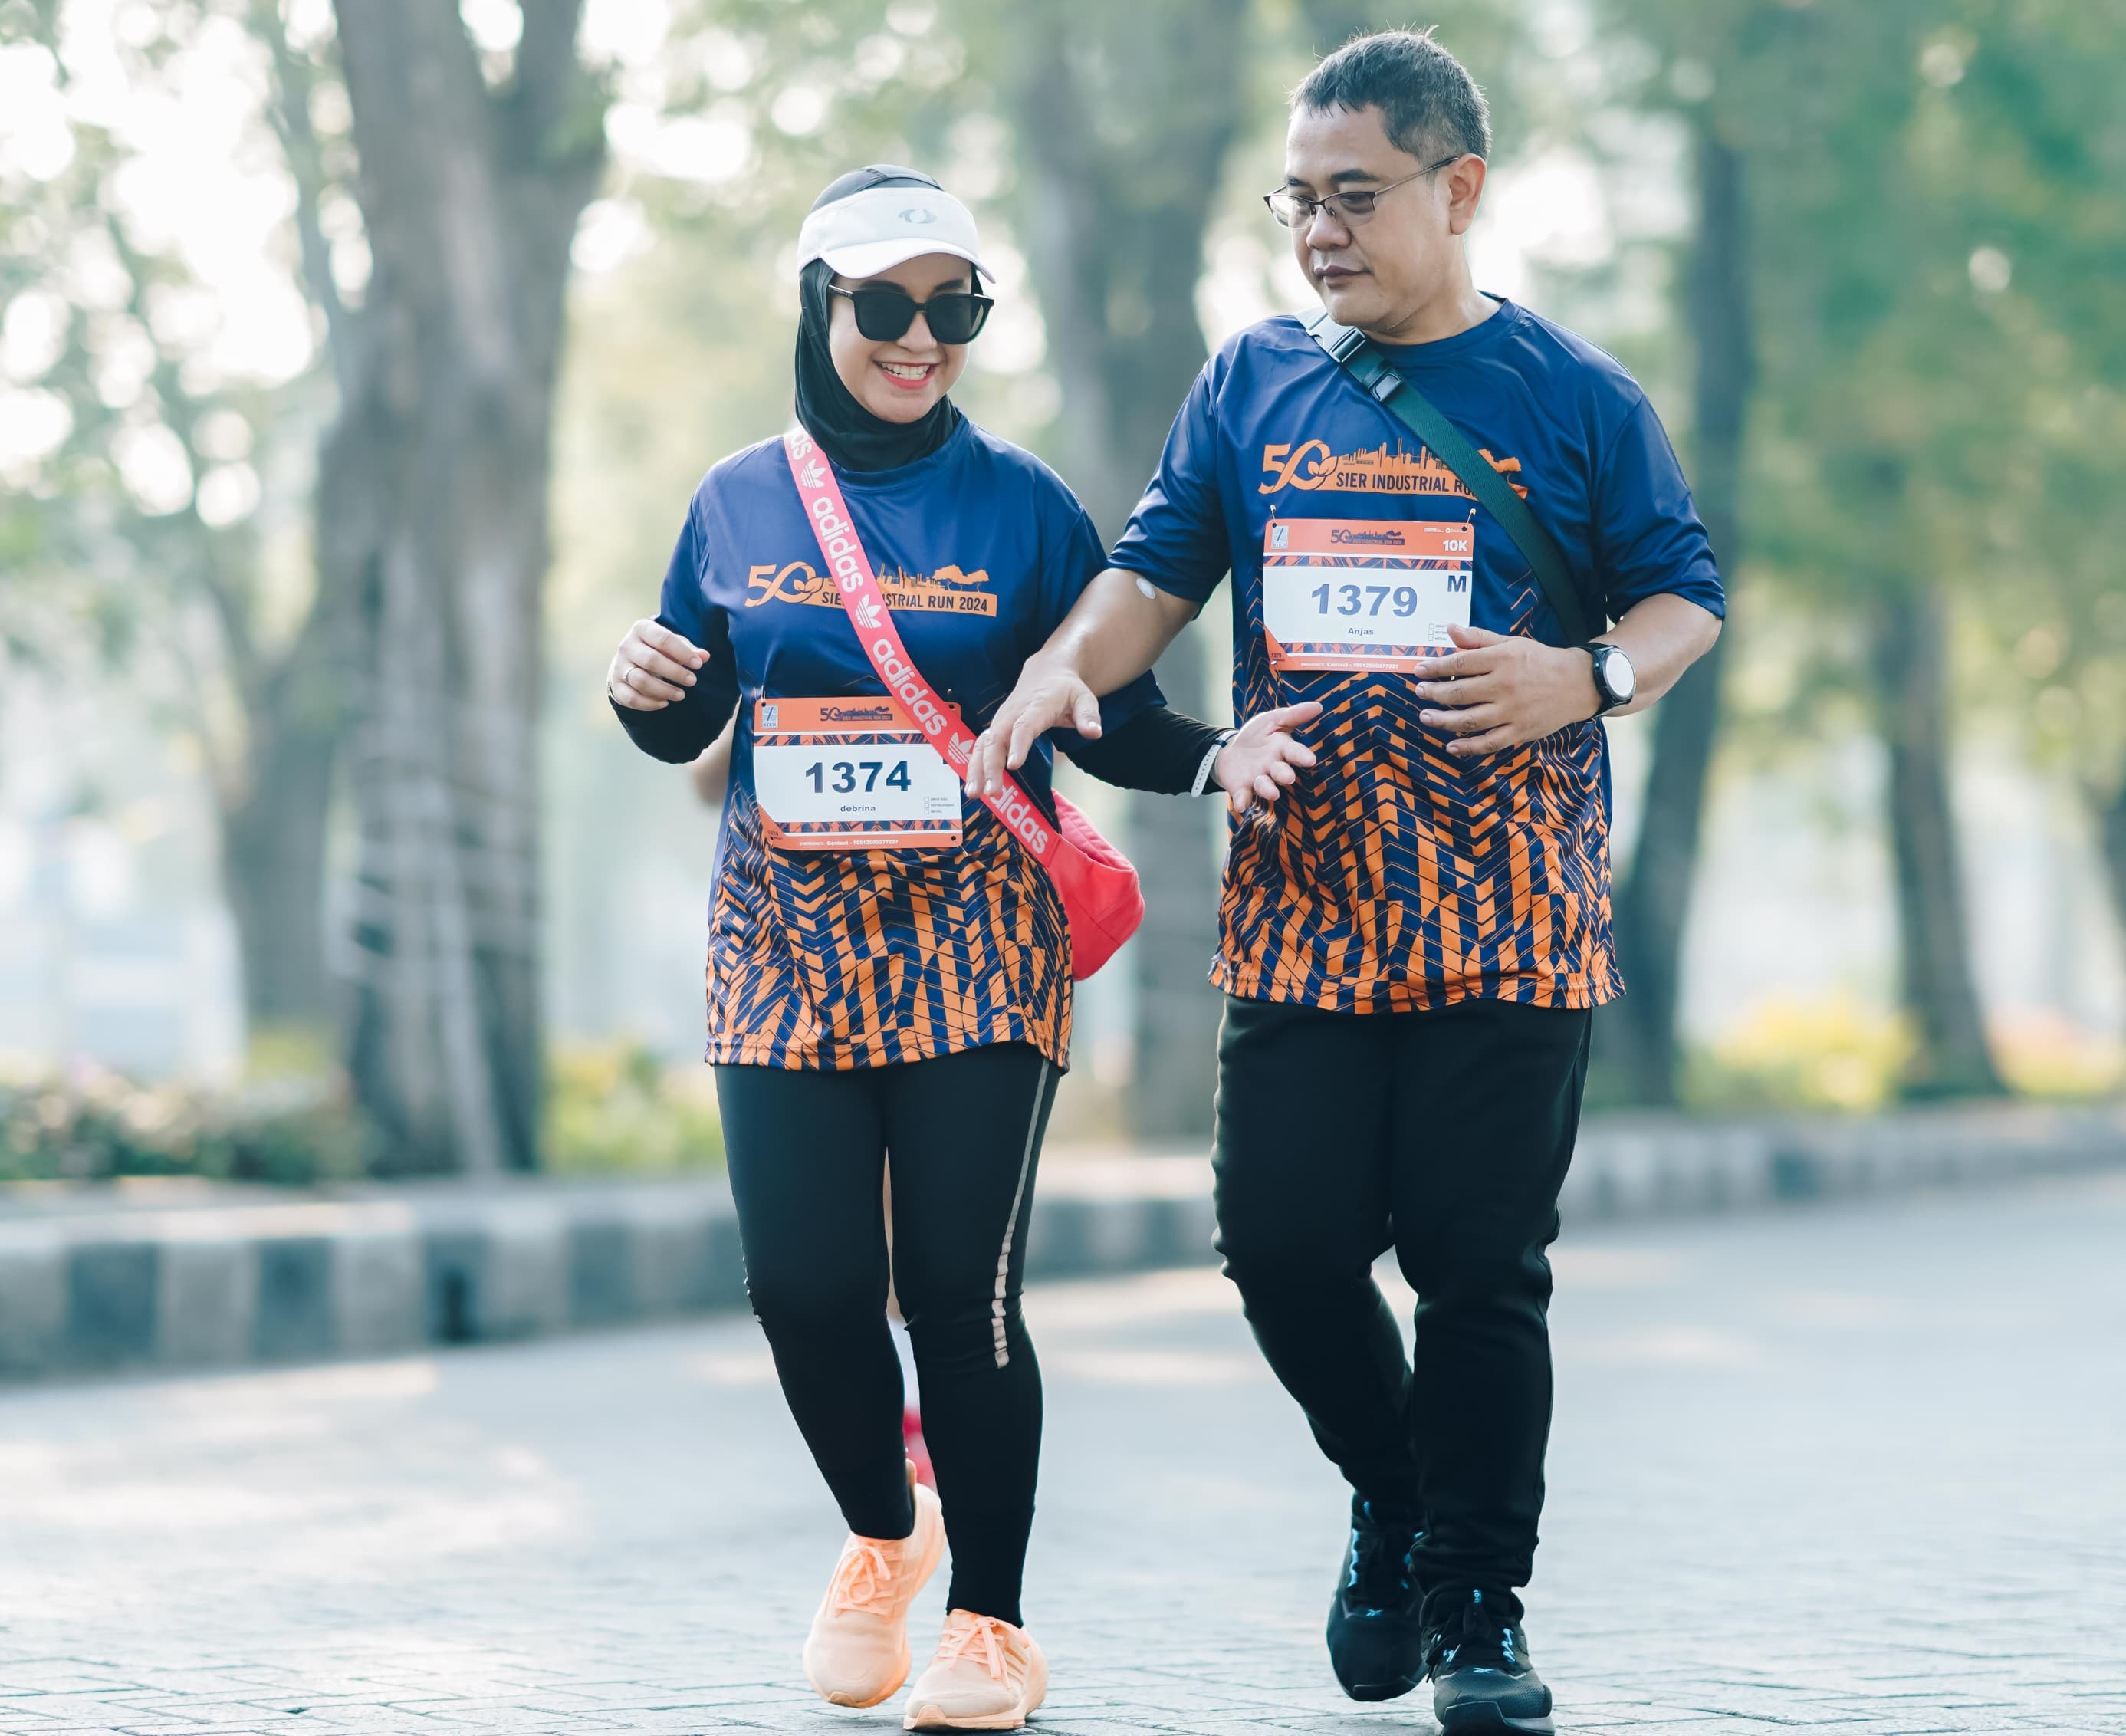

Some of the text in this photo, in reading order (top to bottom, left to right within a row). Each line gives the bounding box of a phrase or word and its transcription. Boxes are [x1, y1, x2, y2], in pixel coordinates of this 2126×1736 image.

[1336, 472, 1476, 497] SIER INDUSTRIAL RU
[813, 496, 864, 593] adidas
[1442, 539, 1468, 552] 10K
[1447, 575, 1467, 593] M
[822, 591, 845, 606] SIE
[928, 595, 955, 609] RUN
[959, 597, 988, 612] 2024
[1311, 583, 1418, 618] 1379
[1347, 627, 1375, 636] Anjas
[872, 638, 948, 736] adidas
[805, 761, 912, 794] 1374
[840, 804, 876, 813] debrina
[990, 784, 1048, 854] didas
